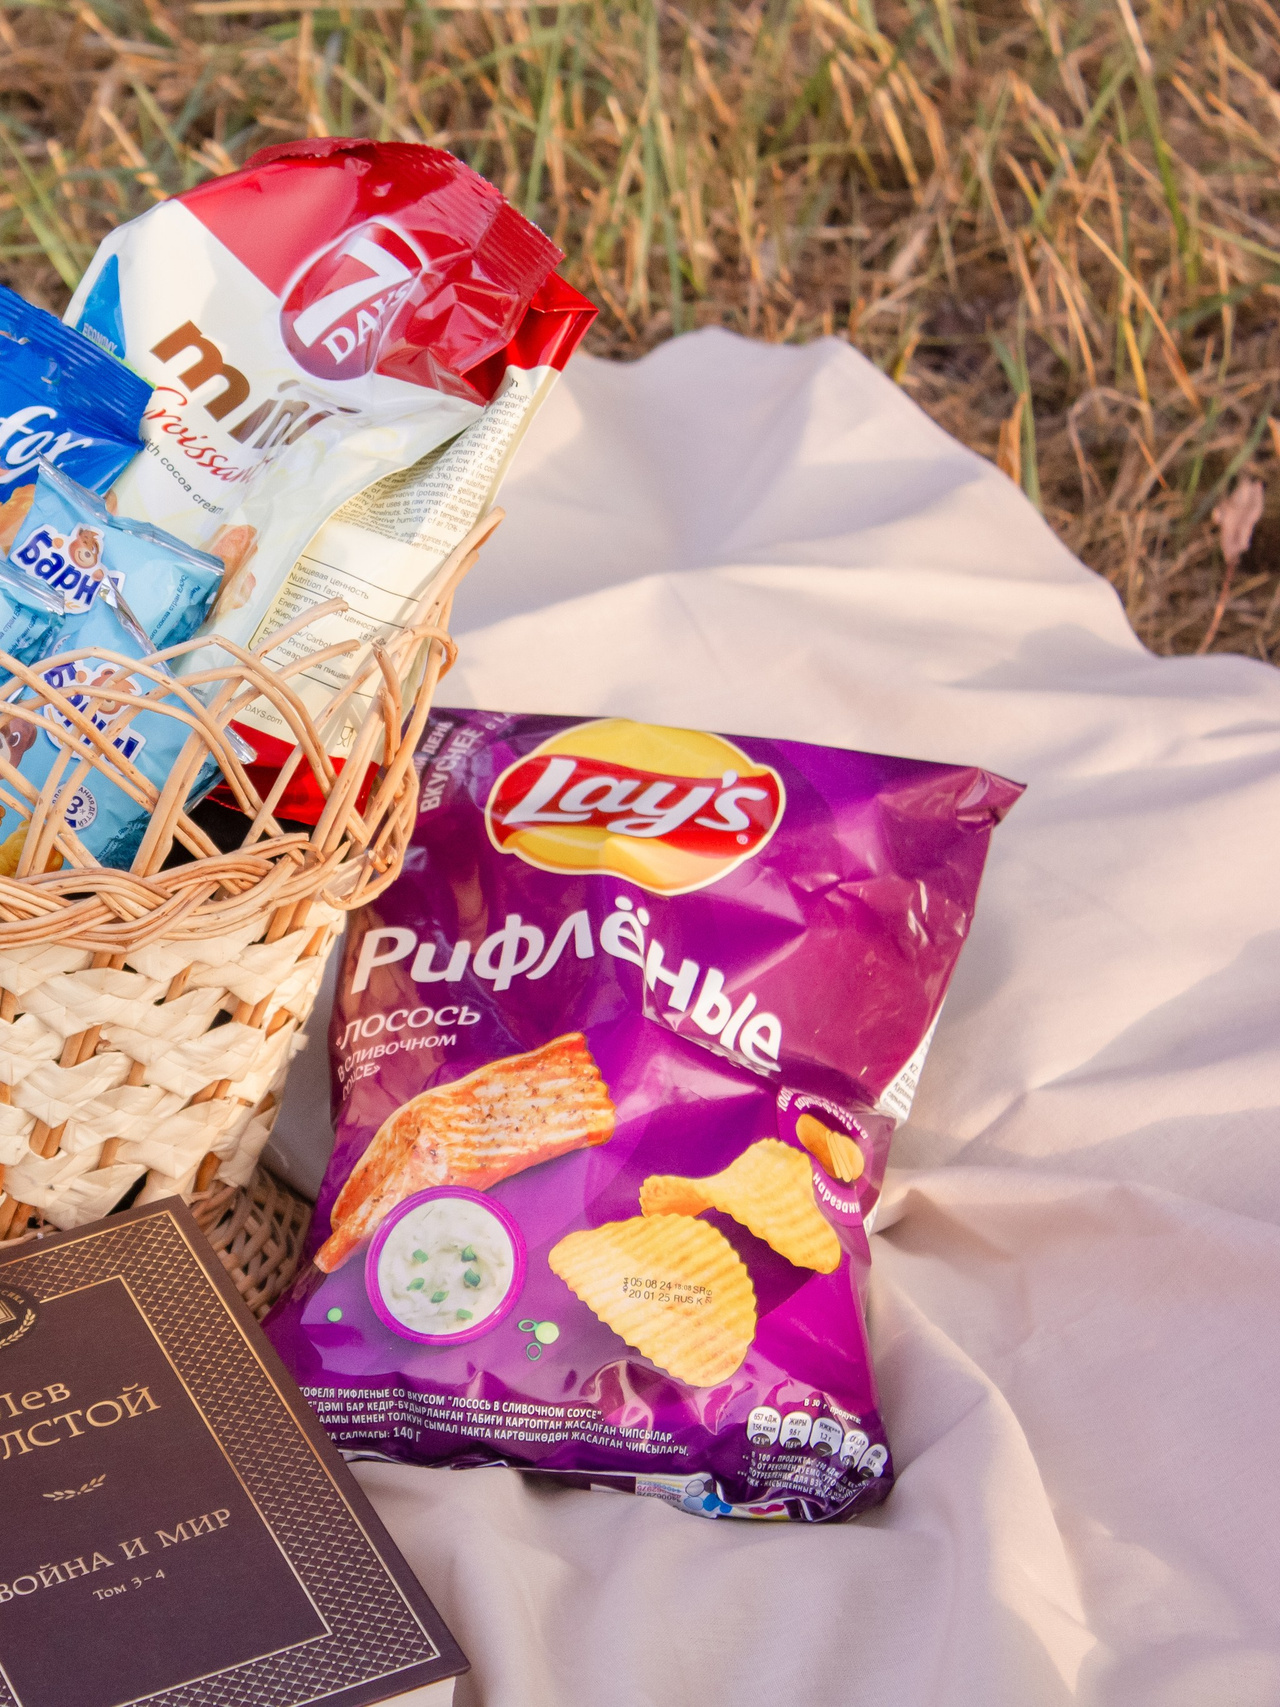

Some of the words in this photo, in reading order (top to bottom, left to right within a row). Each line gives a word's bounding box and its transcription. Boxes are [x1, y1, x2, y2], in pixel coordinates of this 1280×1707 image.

[293, 236, 412, 348] 7
[321, 282, 411, 365] DAYS
[160, 457, 192, 492] cocoa
[289, 572, 322, 590] Nutrition
[294, 562, 328, 580] Пищевая
[330, 577, 369, 600] ценность
[278, 598, 301, 612] Energy
[502, 758, 768, 838] Lay's
[350, 897, 782, 1063] Рифлёные
[337, 1065, 345, 1082] В
[345, 1034, 457, 1073] СЛИВОЧНОМ
[628, 1289, 641, 1298] 20
[643, 1290, 655, 1300] 01
[658, 1293, 670, 1302] 25
[673, 1294, 694, 1304] RUS
[630, 1277, 642, 1287] 05
[645, 1279, 657, 1289] 08
[659, 1280, 672, 1291] 24
[692, 1285, 706, 1295] SR
[299, 1387, 335, 1398] ТОФЕЛЯ
[337, 1388, 390, 1399] РИФЛЕНЫЕ
[392, 1388, 405, 1398] СО
[407, 1391, 445, 1406] ВКУСОМ
[447, 1396, 490, 1410] "ЛОСОСЬ
[493, 1401, 500, 1411] В
[502, 1402, 564, 1418] СЛИВОЧНОМ
[319, 1415, 349, 1425] ААМЫ
[351, 1414, 385, 1424] МЕНЕН
[387, 1412, 422, 1426] ТОЛКУН
[423, 1420, 459, 1434] СЫМАЛ
[460, 1426, 492, 1439] НАКТА
[571, 1431, 623, 1449] ЖАСАЛГАН
[625, 1441, 690, 1456] ЧИПСЫЛАРЫ.
[346, 1401, 364, 1412] БАР
[505, 1416, 562, 1430] КАРТОПТАН
[619, 1427, 675, 1443] ЧИПСЫЛАР.
[393, 1427, 413, 1440] 140
[789, 1418, 807, 1426] ЖИРЫ
[118, 1537, 149, 1560] И
[154, 1508, 231, 1548] МИР
[93, 1584, 127, 1600] Том
